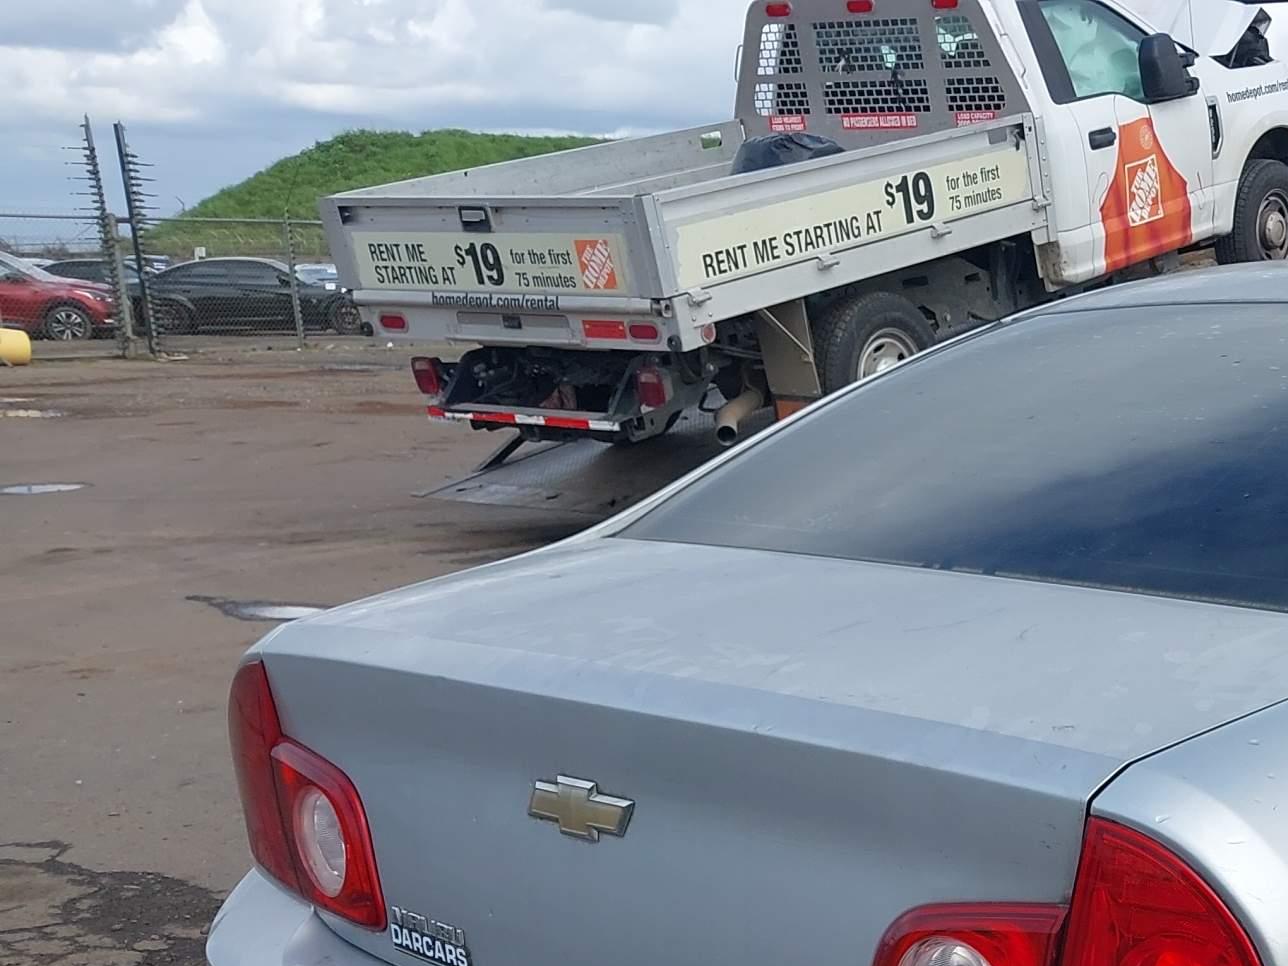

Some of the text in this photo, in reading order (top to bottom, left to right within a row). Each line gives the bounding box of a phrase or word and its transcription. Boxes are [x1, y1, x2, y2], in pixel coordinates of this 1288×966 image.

[970, 112, 994, 120] CAPACITY
[946, 164, 1000, 192] for the first
[949, 187, 1002, 212] 75 minutes
[1129, 159, 1157, 223] HOME
[702, 171, 935, 278] RENT ME STARTING AT $19
[368, 243, 428, 263] RENT ME
[374, 242, 505, 286] STARTING AT $19
[510, 248, 573, 265] for the first
[583, 239, 609, 289] HOME
[515, 272, 577, 289] 75 minutes
[431, 291, 560, 311] homedepot.com/rental
